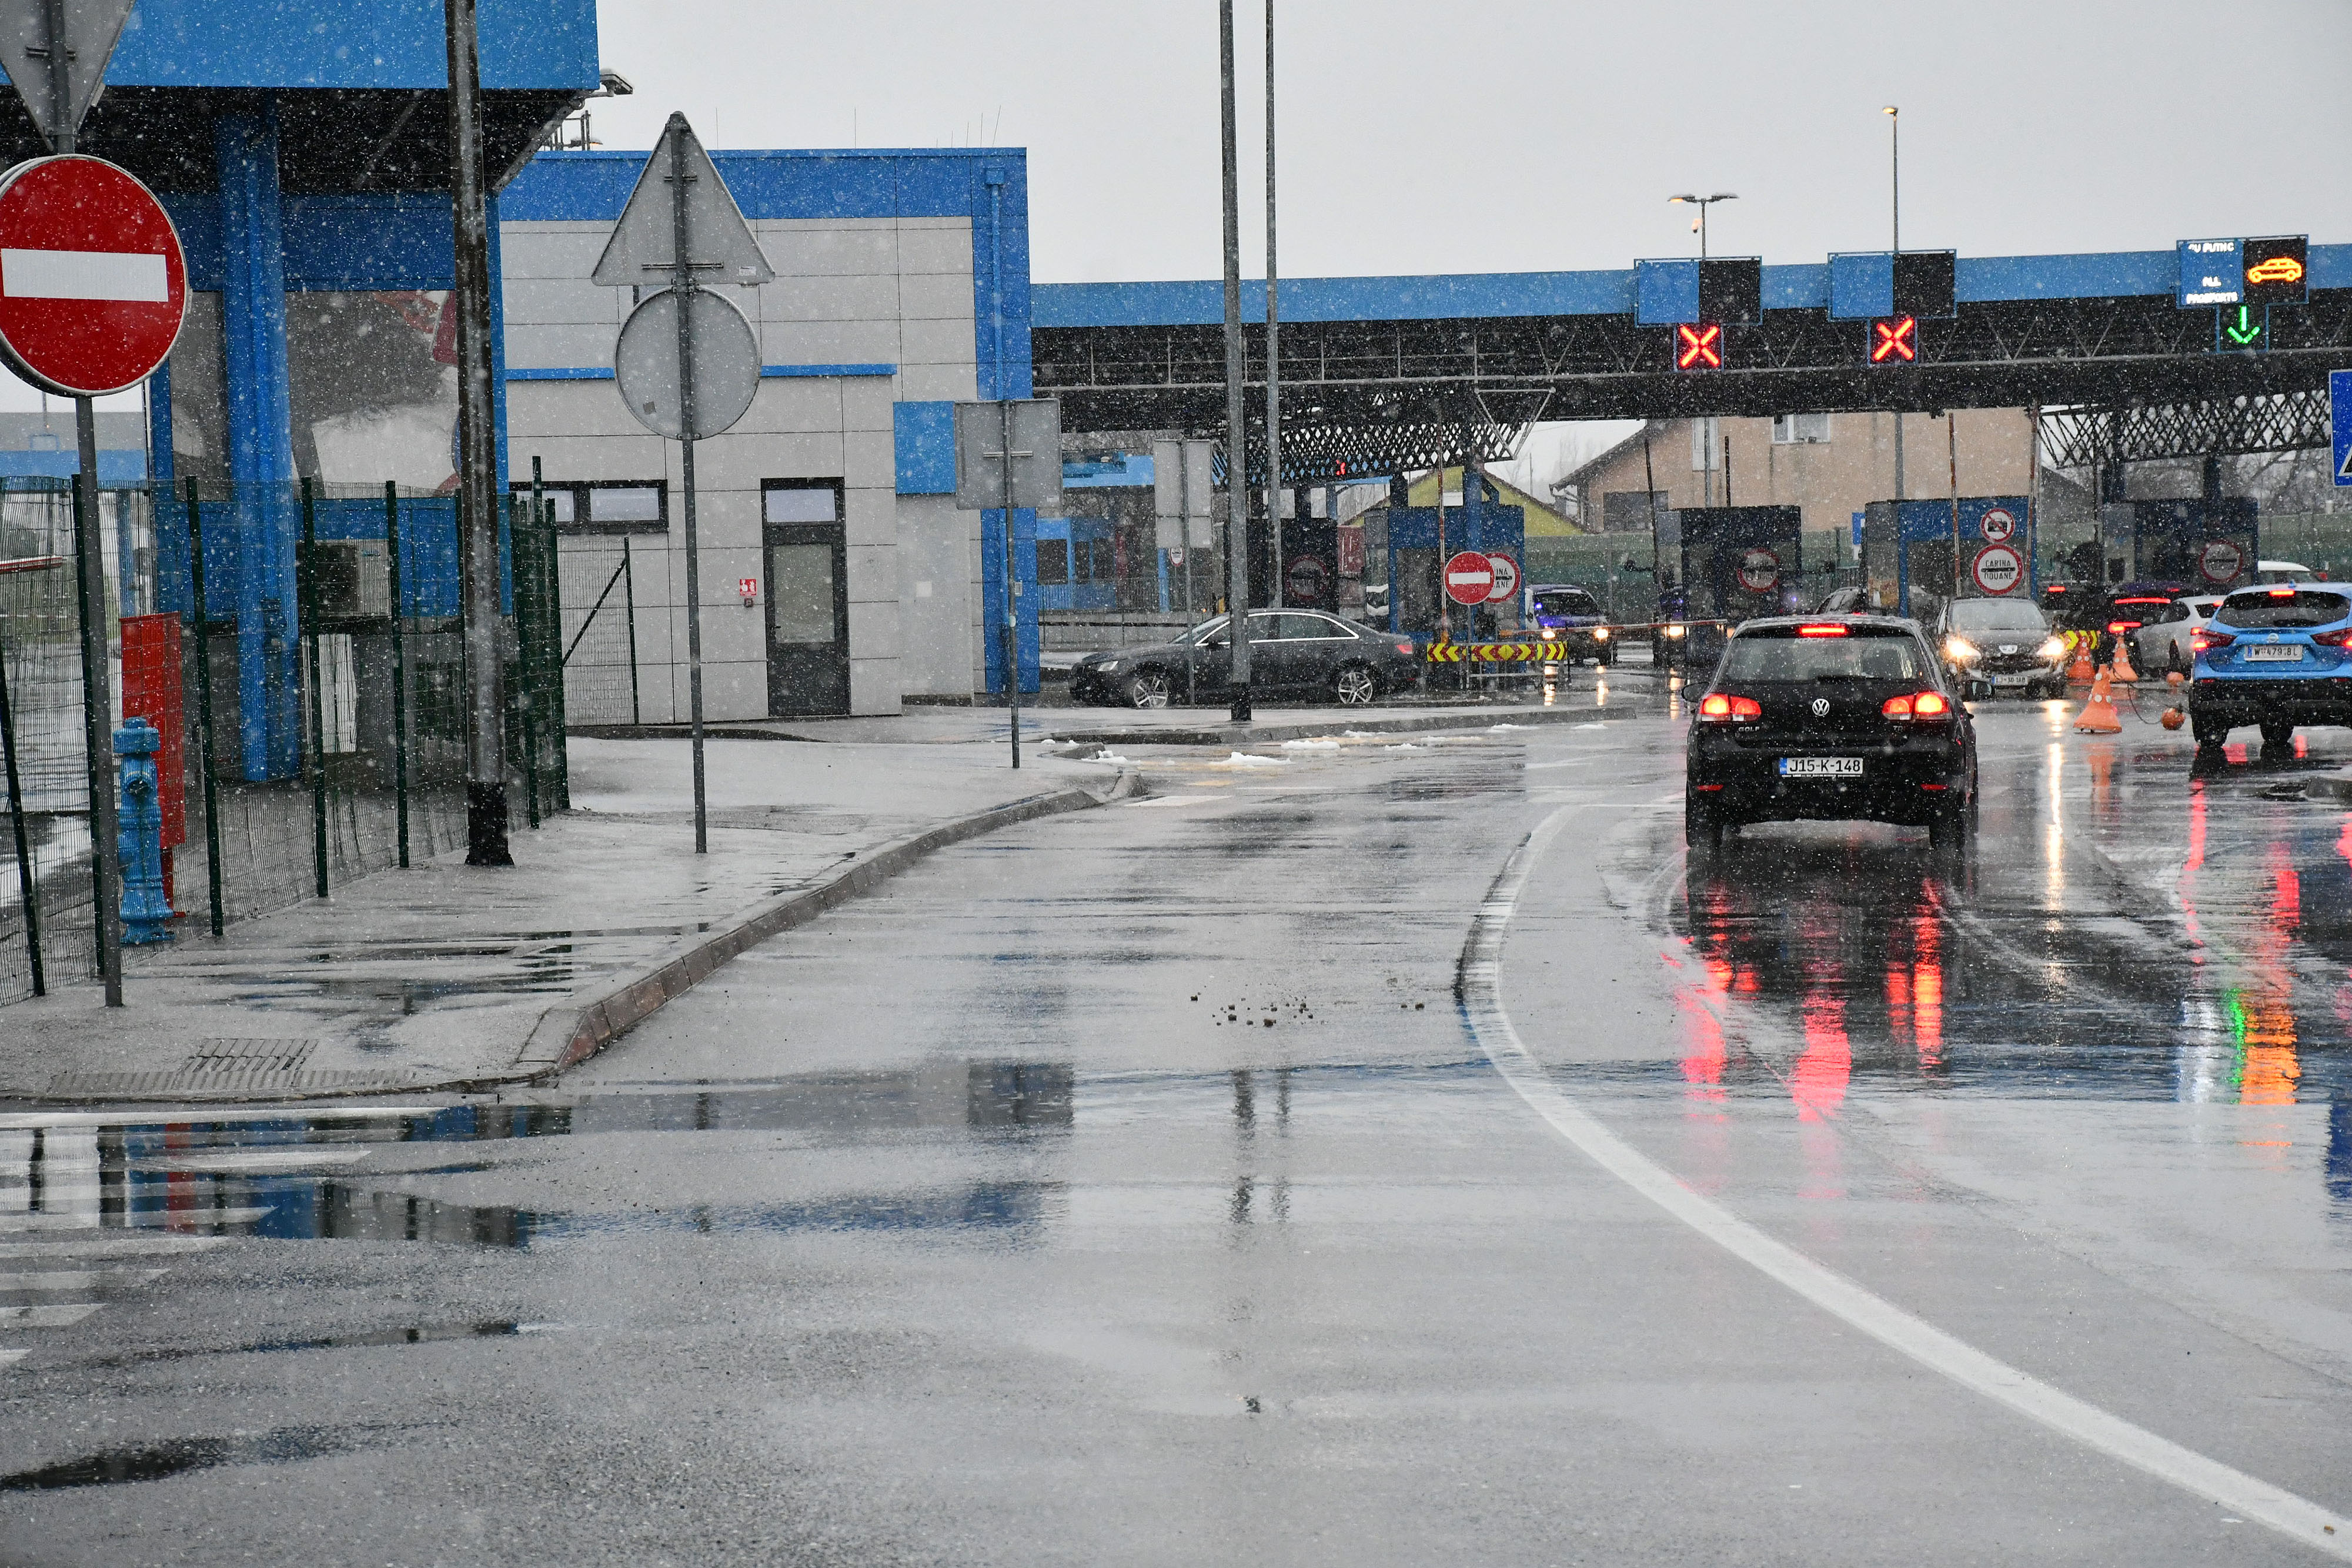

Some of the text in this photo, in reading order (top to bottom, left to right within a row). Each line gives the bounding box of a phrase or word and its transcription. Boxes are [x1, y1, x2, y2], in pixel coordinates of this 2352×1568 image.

[2203, 276, 2221, 286] ALL
[1984, 572, 2013, 580] DOUANE
[1789, 759, 1861, 773] J15-K-148
